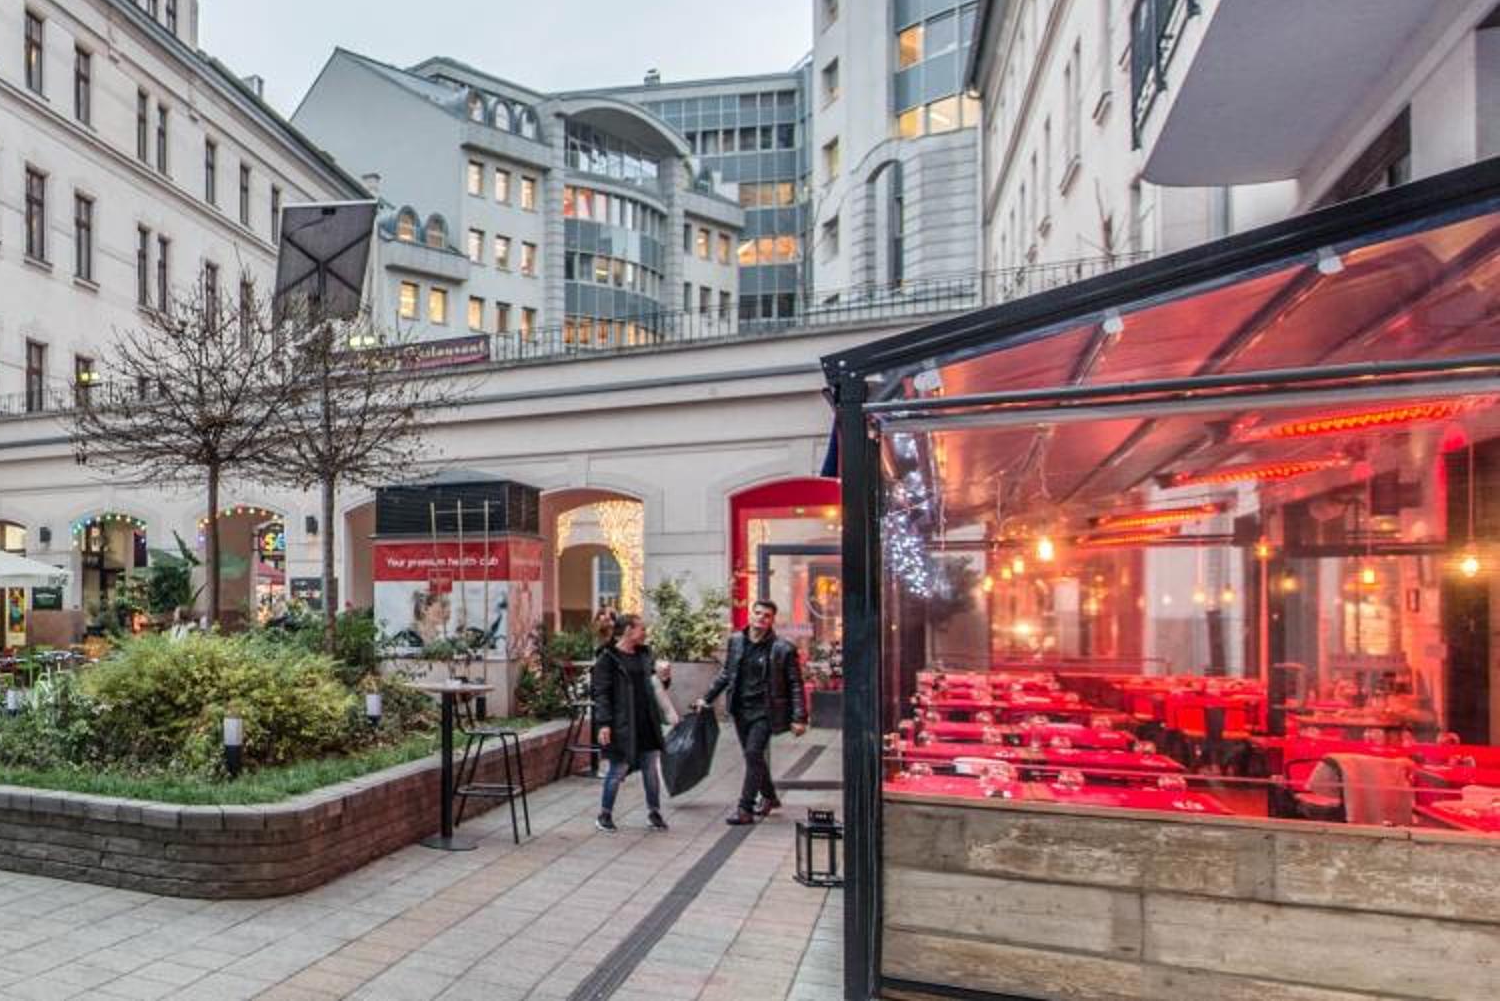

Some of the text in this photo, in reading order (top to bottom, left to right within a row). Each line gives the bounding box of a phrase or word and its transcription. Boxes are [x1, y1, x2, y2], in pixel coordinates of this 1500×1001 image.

[386, 557, 405, 568] Your
[407, 558, 446, 569] premium
[448, 557, 476, 567] health
[479, 556, 499, 567] club
